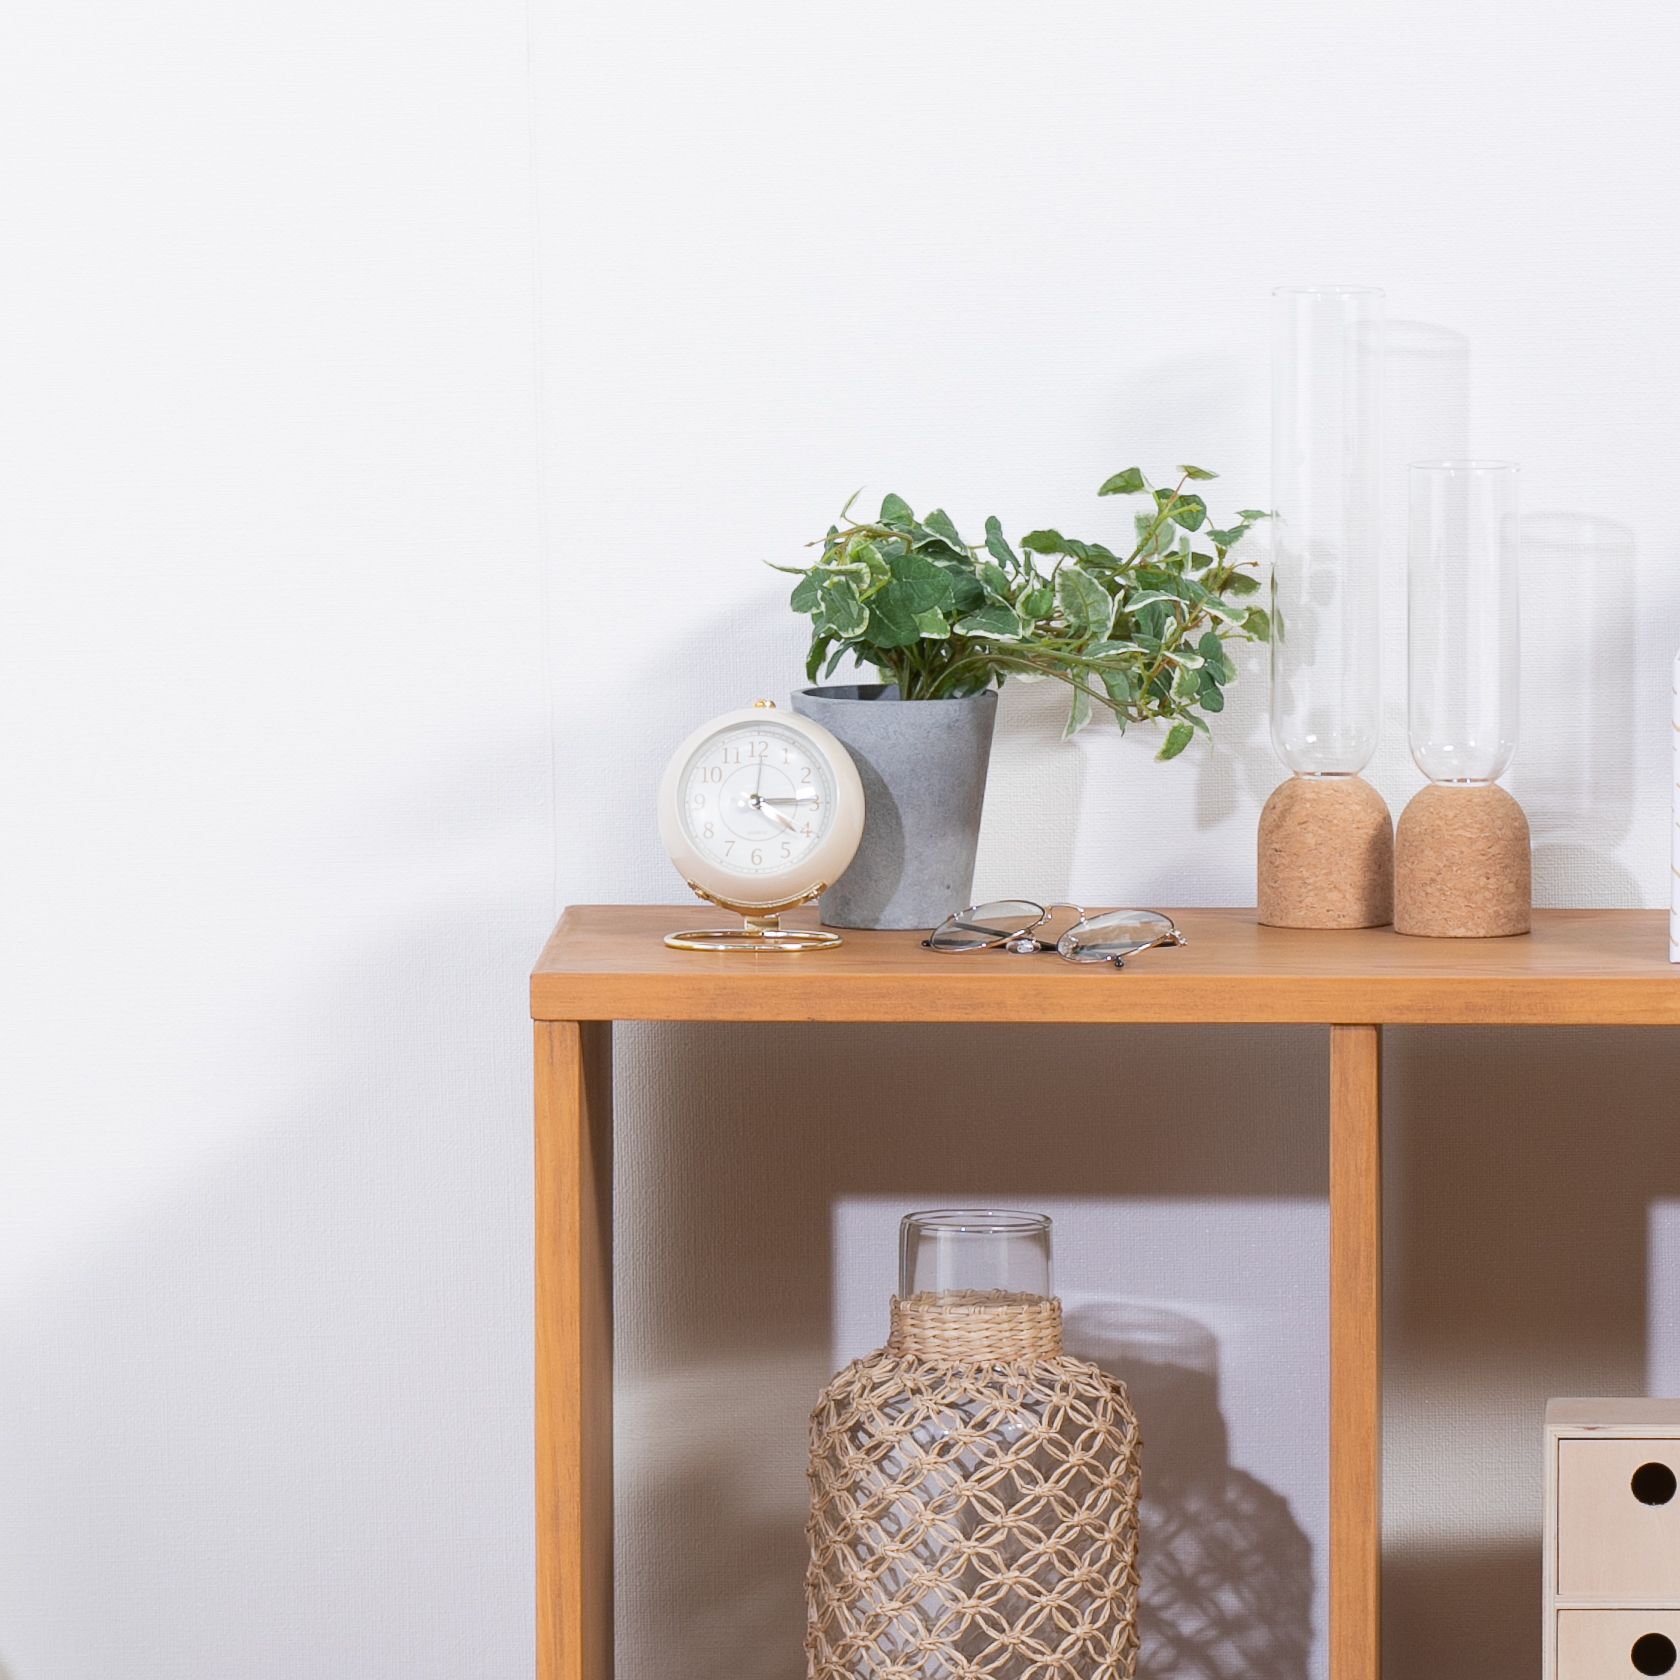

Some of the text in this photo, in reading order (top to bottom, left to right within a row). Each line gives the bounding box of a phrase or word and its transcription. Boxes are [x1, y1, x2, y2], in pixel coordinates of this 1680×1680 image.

[723, 747, 741, 764] 11
[748, 741, 769, 758] 12
[782, 748, 791, 764] 1
[702, 767, 722, 783] 10
[801, 767, 811, 783] 2
[694, 793, 705, 811] 9
[809, 795, 820, 812] 3
[703, 822, 714, 839] 8
[800, 821, 813, 838] 4
[725, 841, 736, 857] 7
[751, 848, 762, 865] 6
[781, 841, 791, 859] 5
